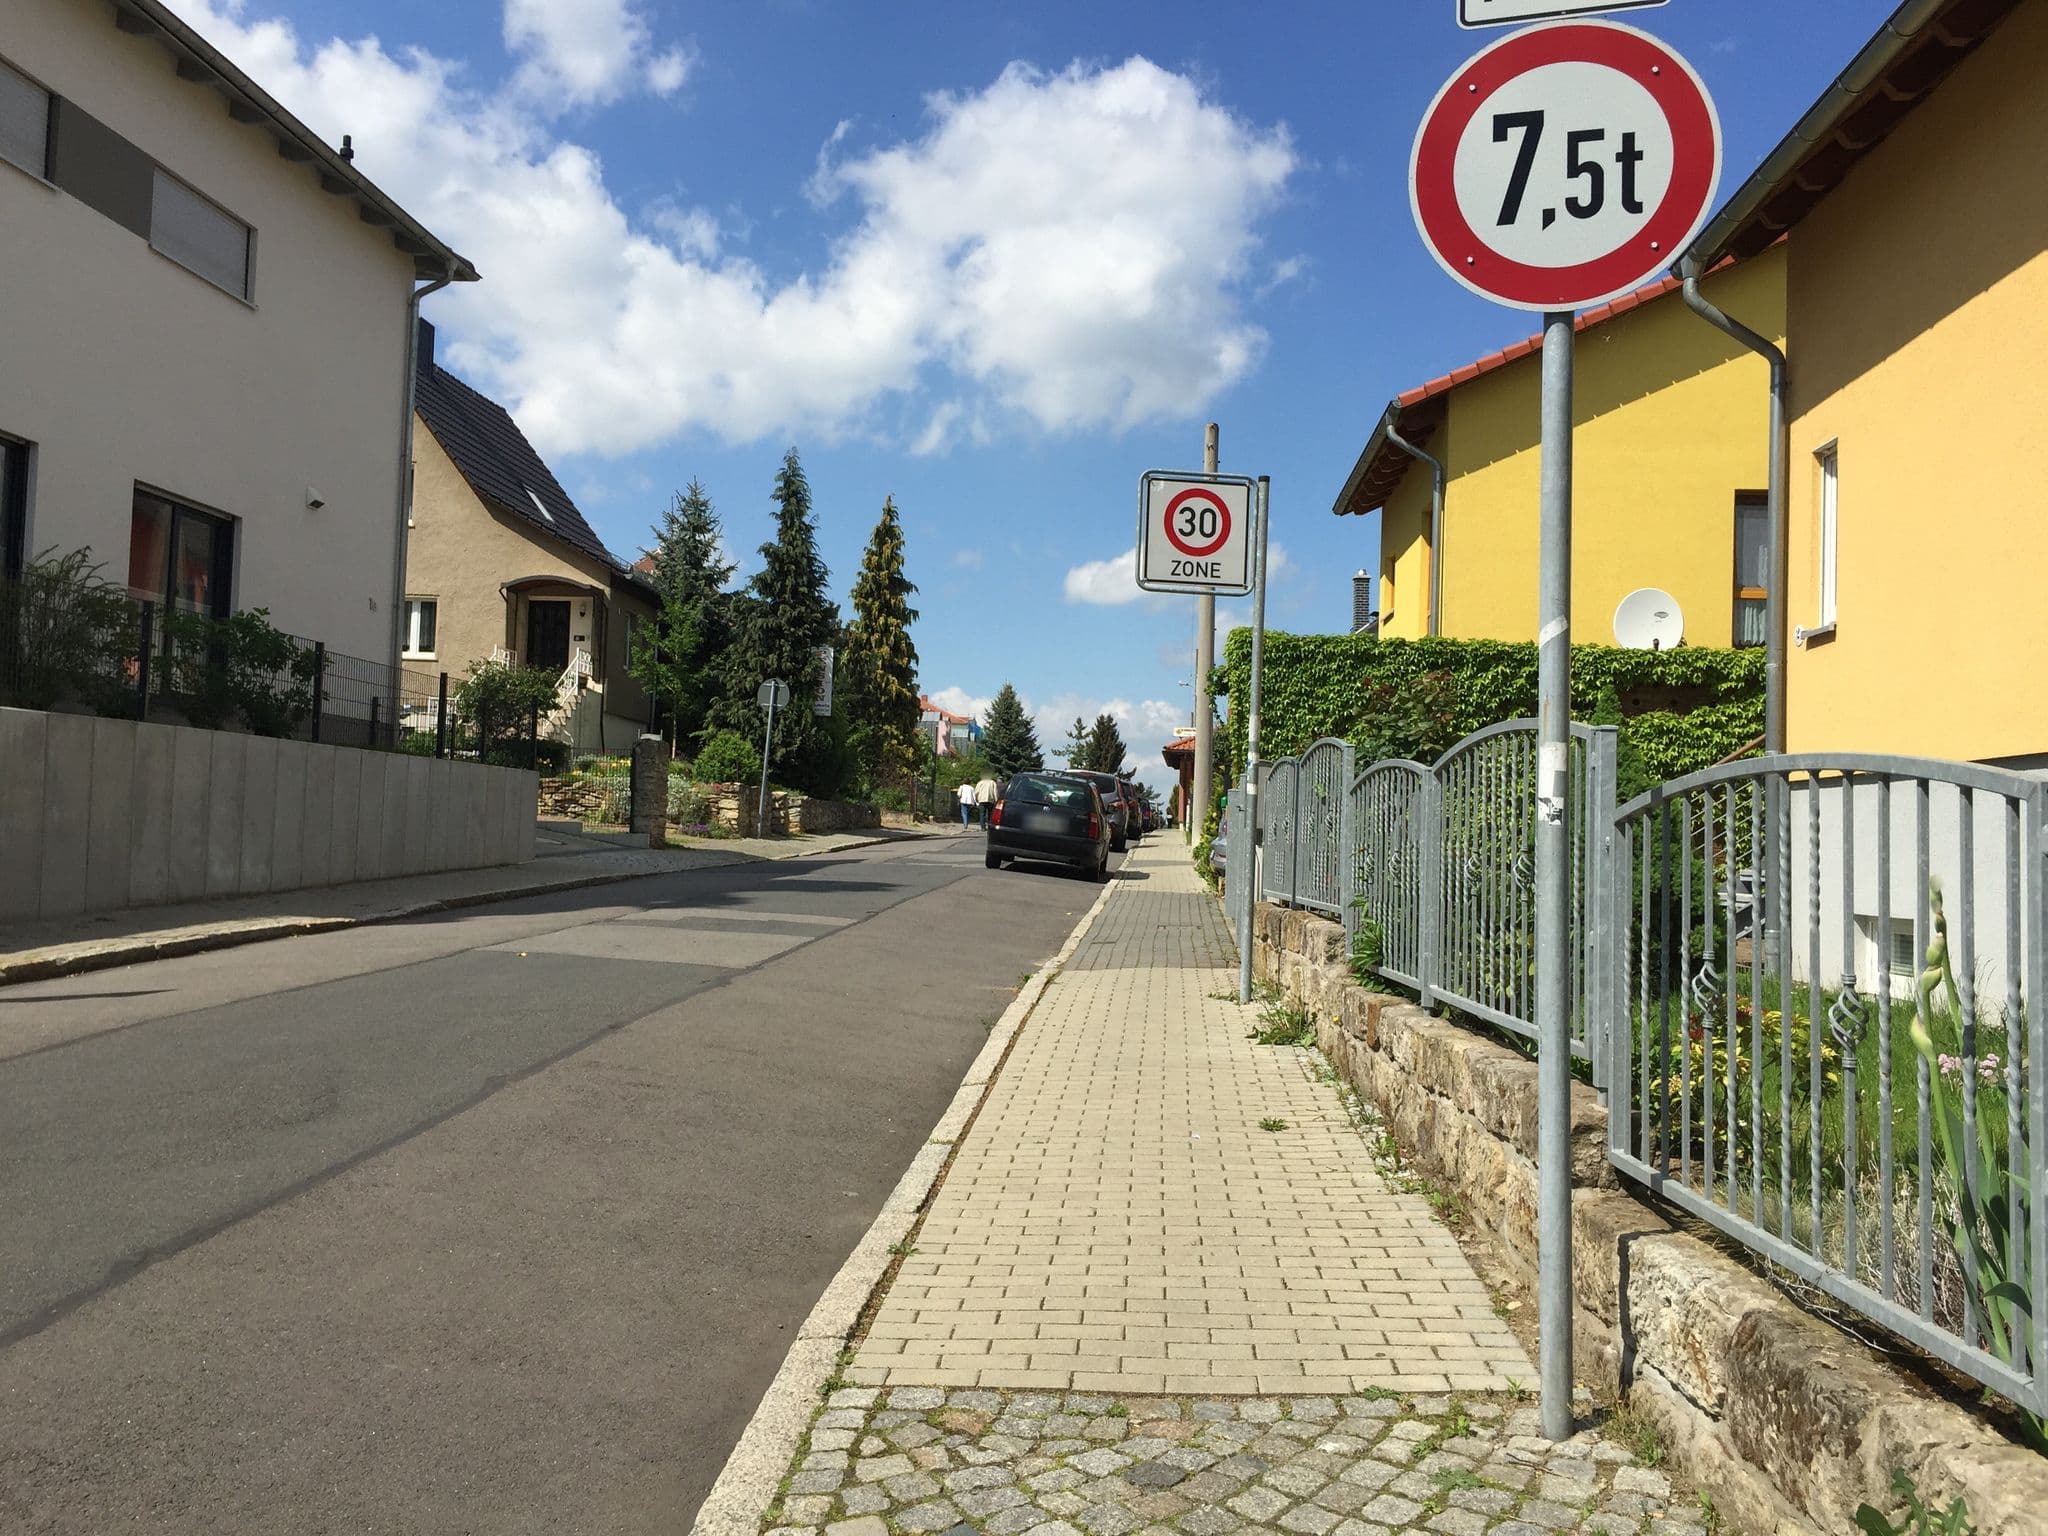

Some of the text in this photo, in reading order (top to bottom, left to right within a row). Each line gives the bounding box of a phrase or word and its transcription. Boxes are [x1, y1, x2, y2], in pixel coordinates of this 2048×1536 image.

[1493, 109, 1643, 231] 7,5t
[1178, 506, 1217, 538] 30
[1171, 560, 1221, 579] ZONE
